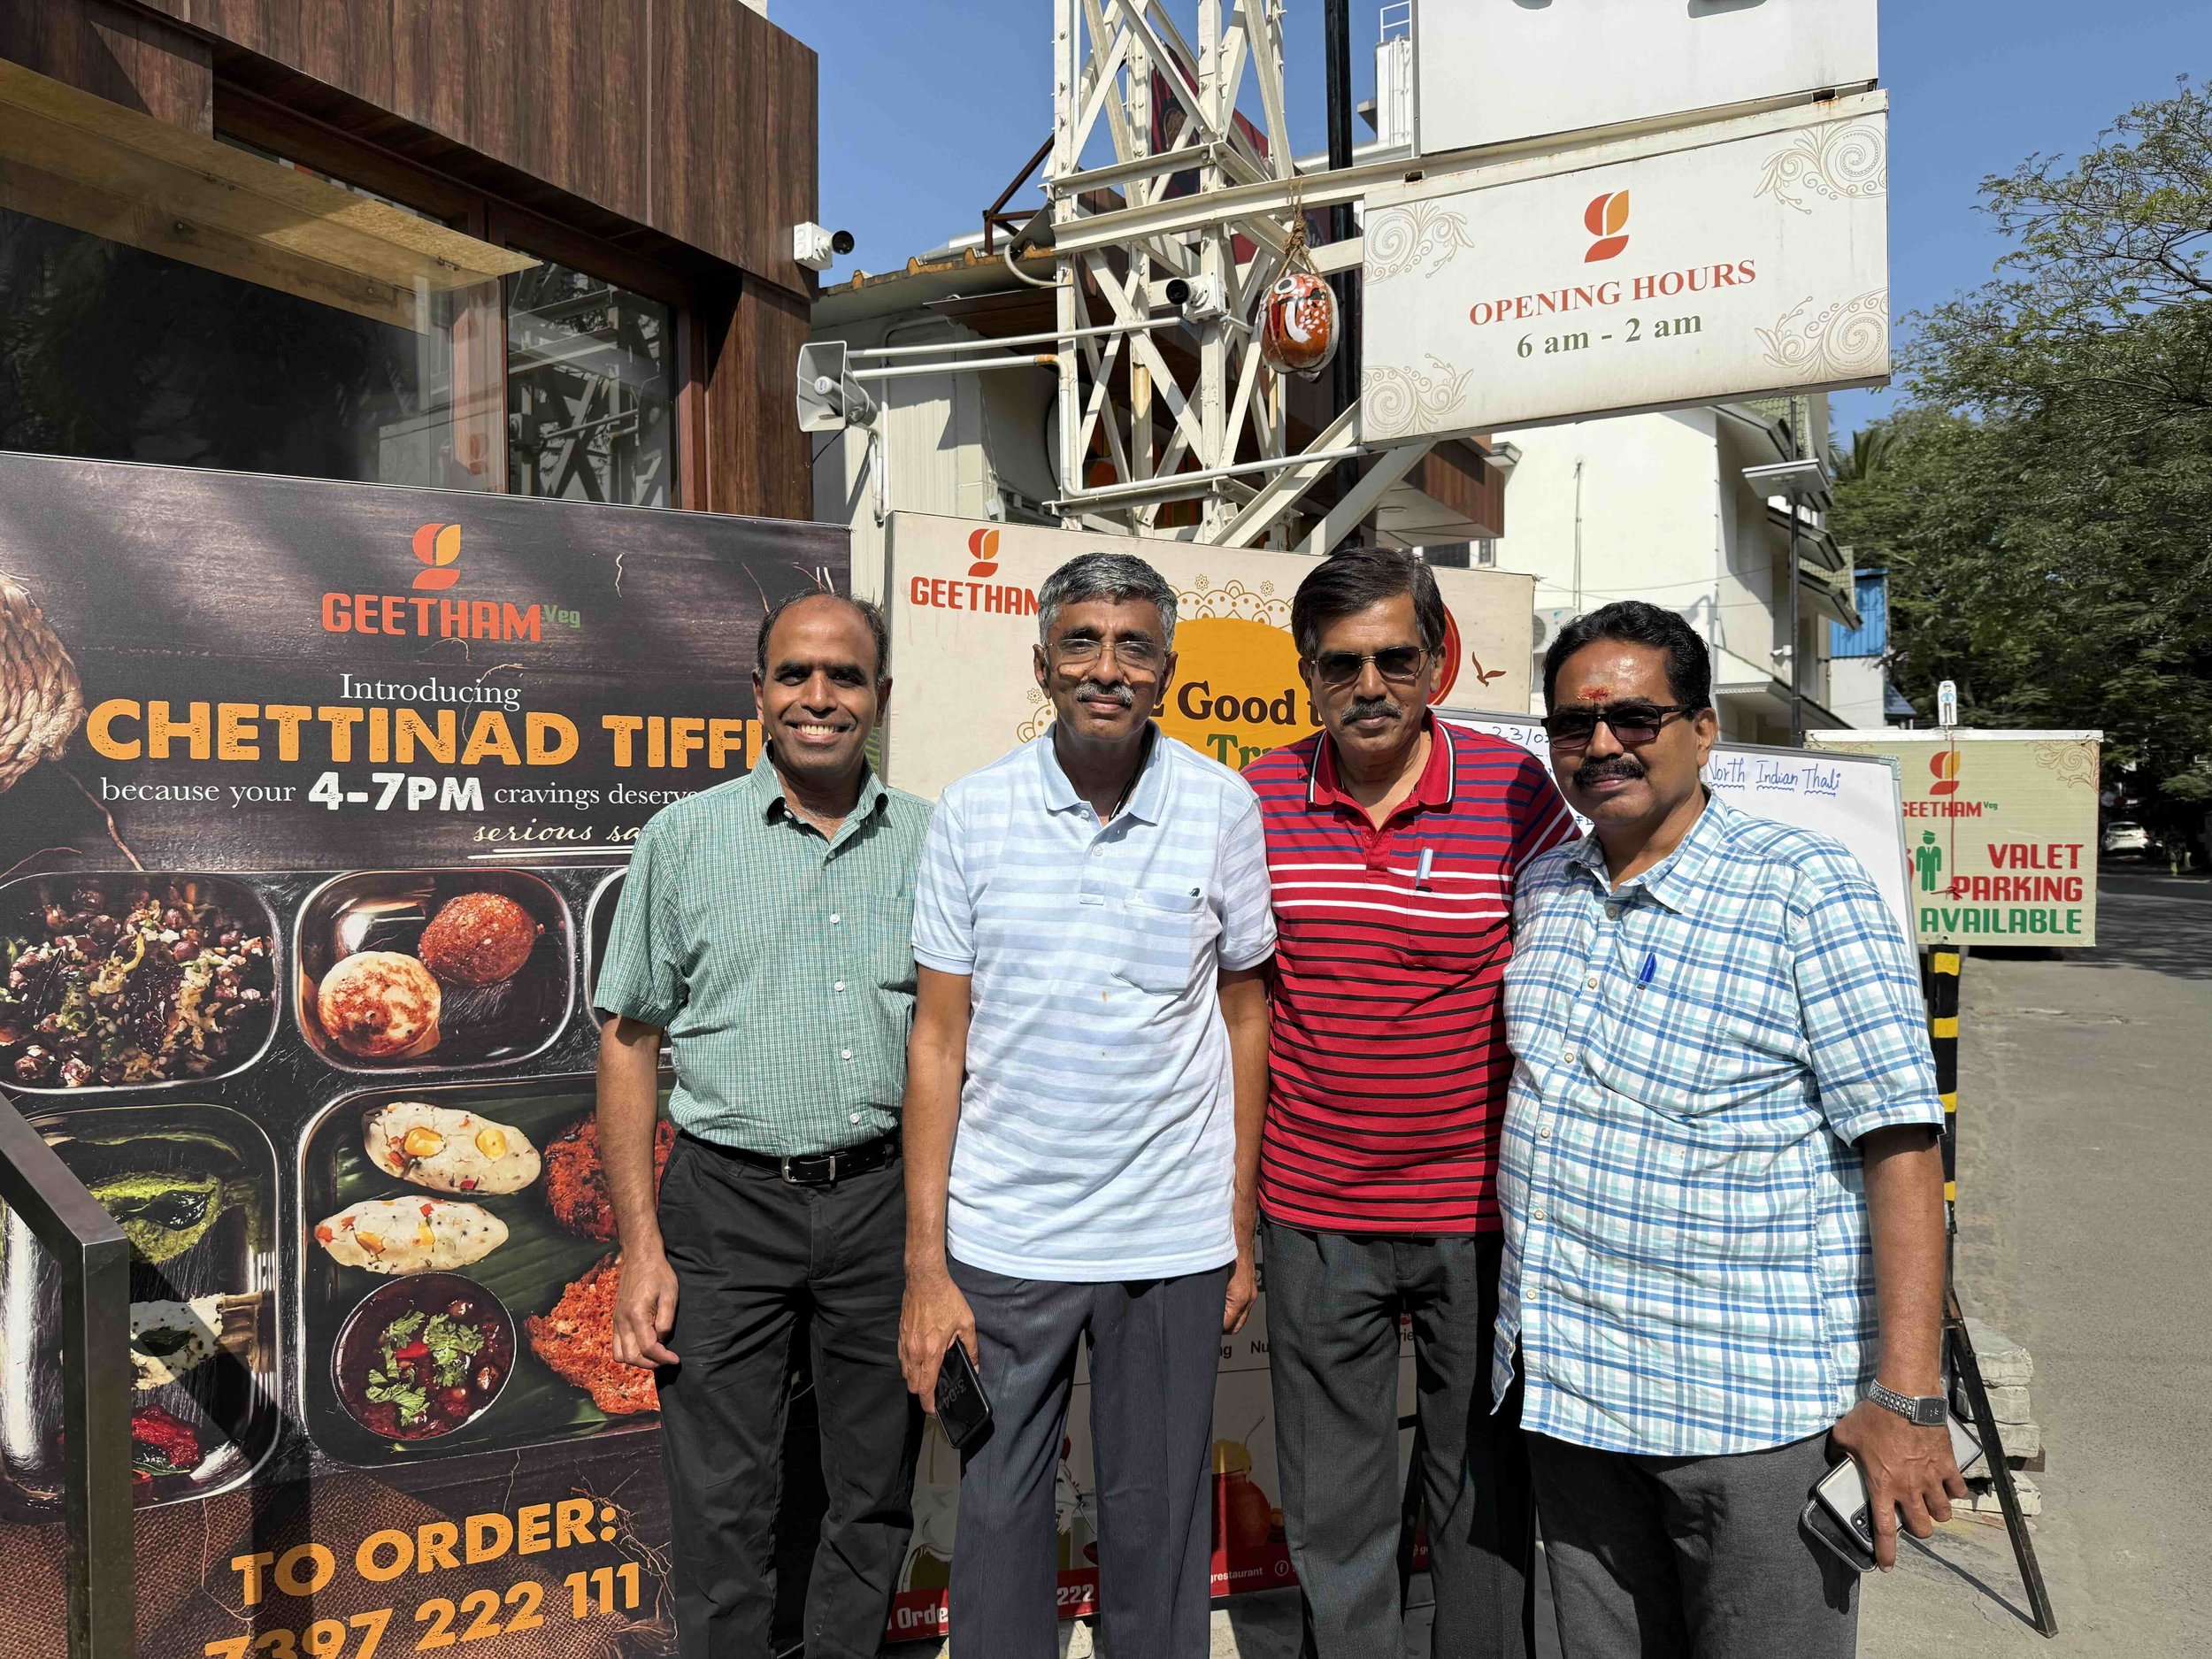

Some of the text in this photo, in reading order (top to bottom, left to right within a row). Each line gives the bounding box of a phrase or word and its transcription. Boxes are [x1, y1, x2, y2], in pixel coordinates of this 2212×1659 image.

[1470, 259, 1756, 326] OPENING HOURS
[1517, 333, 1533, 357] 6
[1544, 330, 1590, 354] am
[1624, 318, 1641, 342] 2
[1655, 315, 1702, 338] am
[322, 592, 580, 642] GEETHAM Veg
[340, 673, 522, 712] Introducing
[1177, 680, 1296, 725] Good
[87, 698, 771, 770] CHETTINAD TIFFI
[101, 777, 220, 802] because
[229, 785, 296, 809] your
[309, 772, 485, 811] 4-7PM
[494, 781, 600, 810] cravings
[1708, 755, 1841, 790] North Indian Thali
[1984, 802, 1998, 810] Veg
[473, 818, 593, 841] serious
[1987, 844, 2084, 870] VALET
[1952, 876, 2083, 902] PARKING
[1920, 908, 2082, 933] AVAILABLE
[231, 1498, 617, 1606] TO ORDER:
[415, 1581, 544, 1651] 222
[564, 1562, 640, 1618] 111
